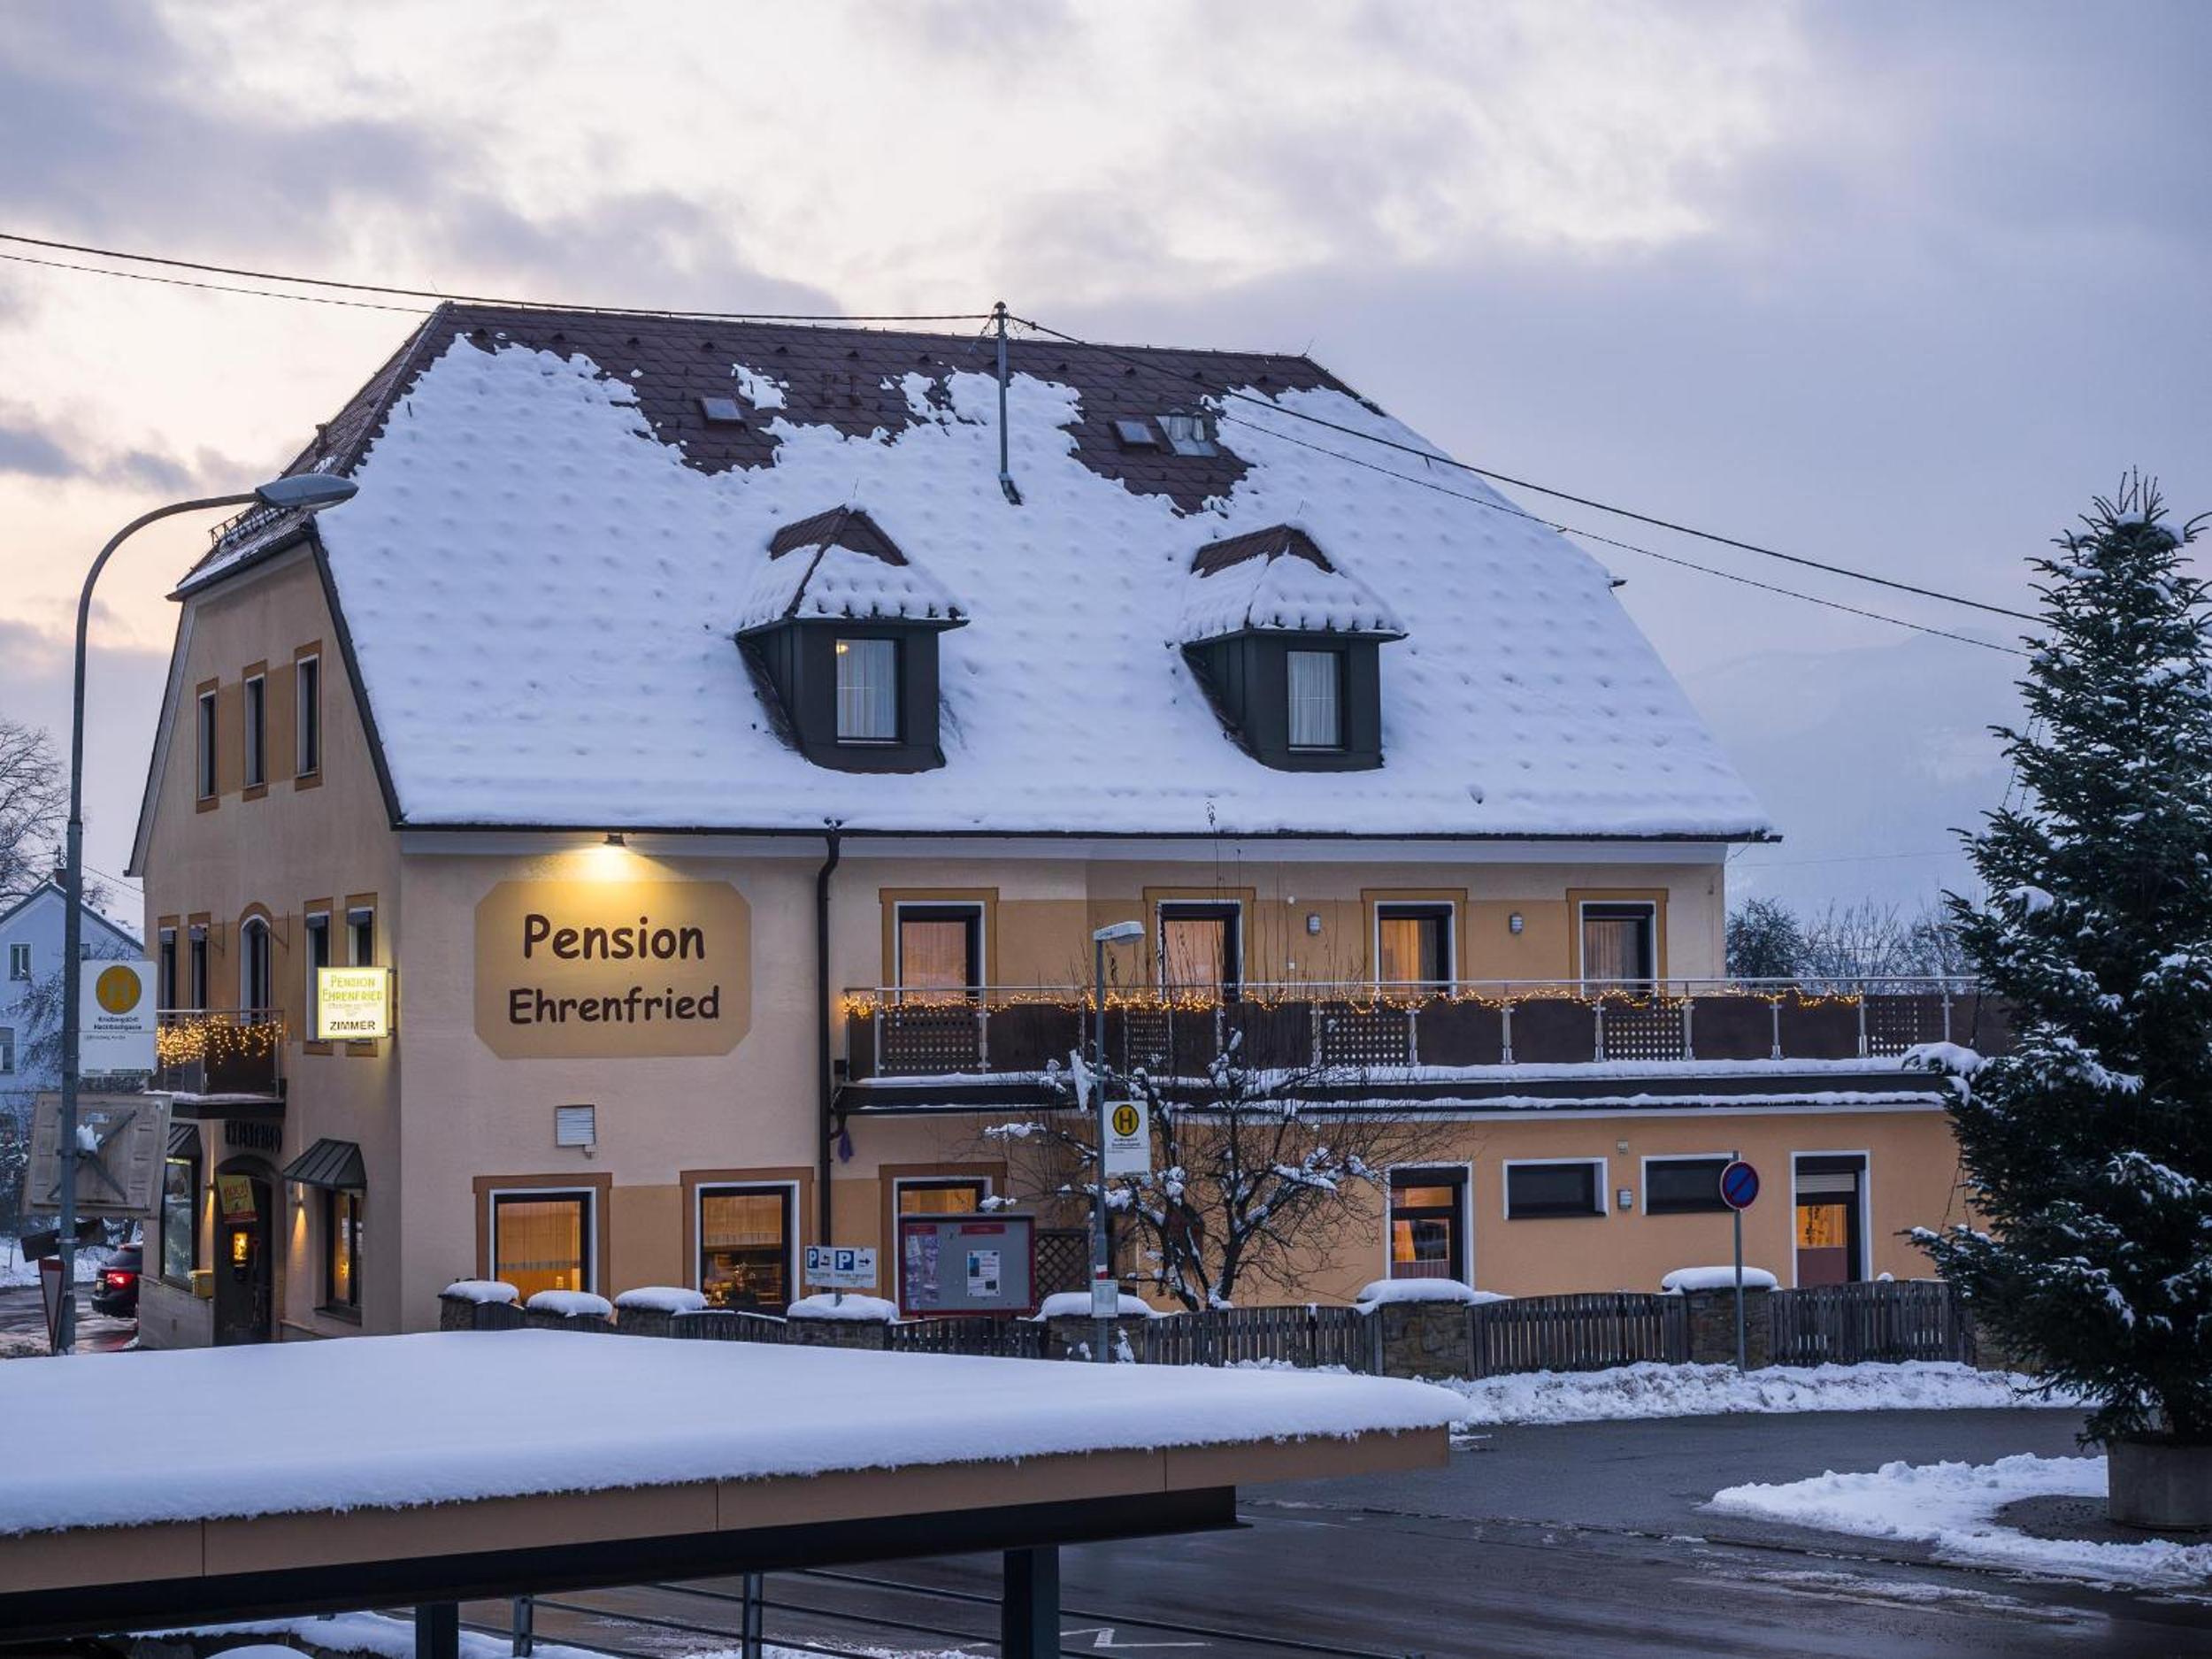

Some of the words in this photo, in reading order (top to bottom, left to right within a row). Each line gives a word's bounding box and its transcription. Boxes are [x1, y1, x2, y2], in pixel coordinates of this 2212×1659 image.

[524, 914, 705, 960] Pension
[330, 974, 376, 987] PENSION
[509, 985, 720, 1025] Ehrenfried
[329, 1020, 376, 1032] ZIMMER
[1118, 1110, 1133, 1131] H
[809, 1248, 818, 1267] P
[838, 1250, 852, 1269] P
